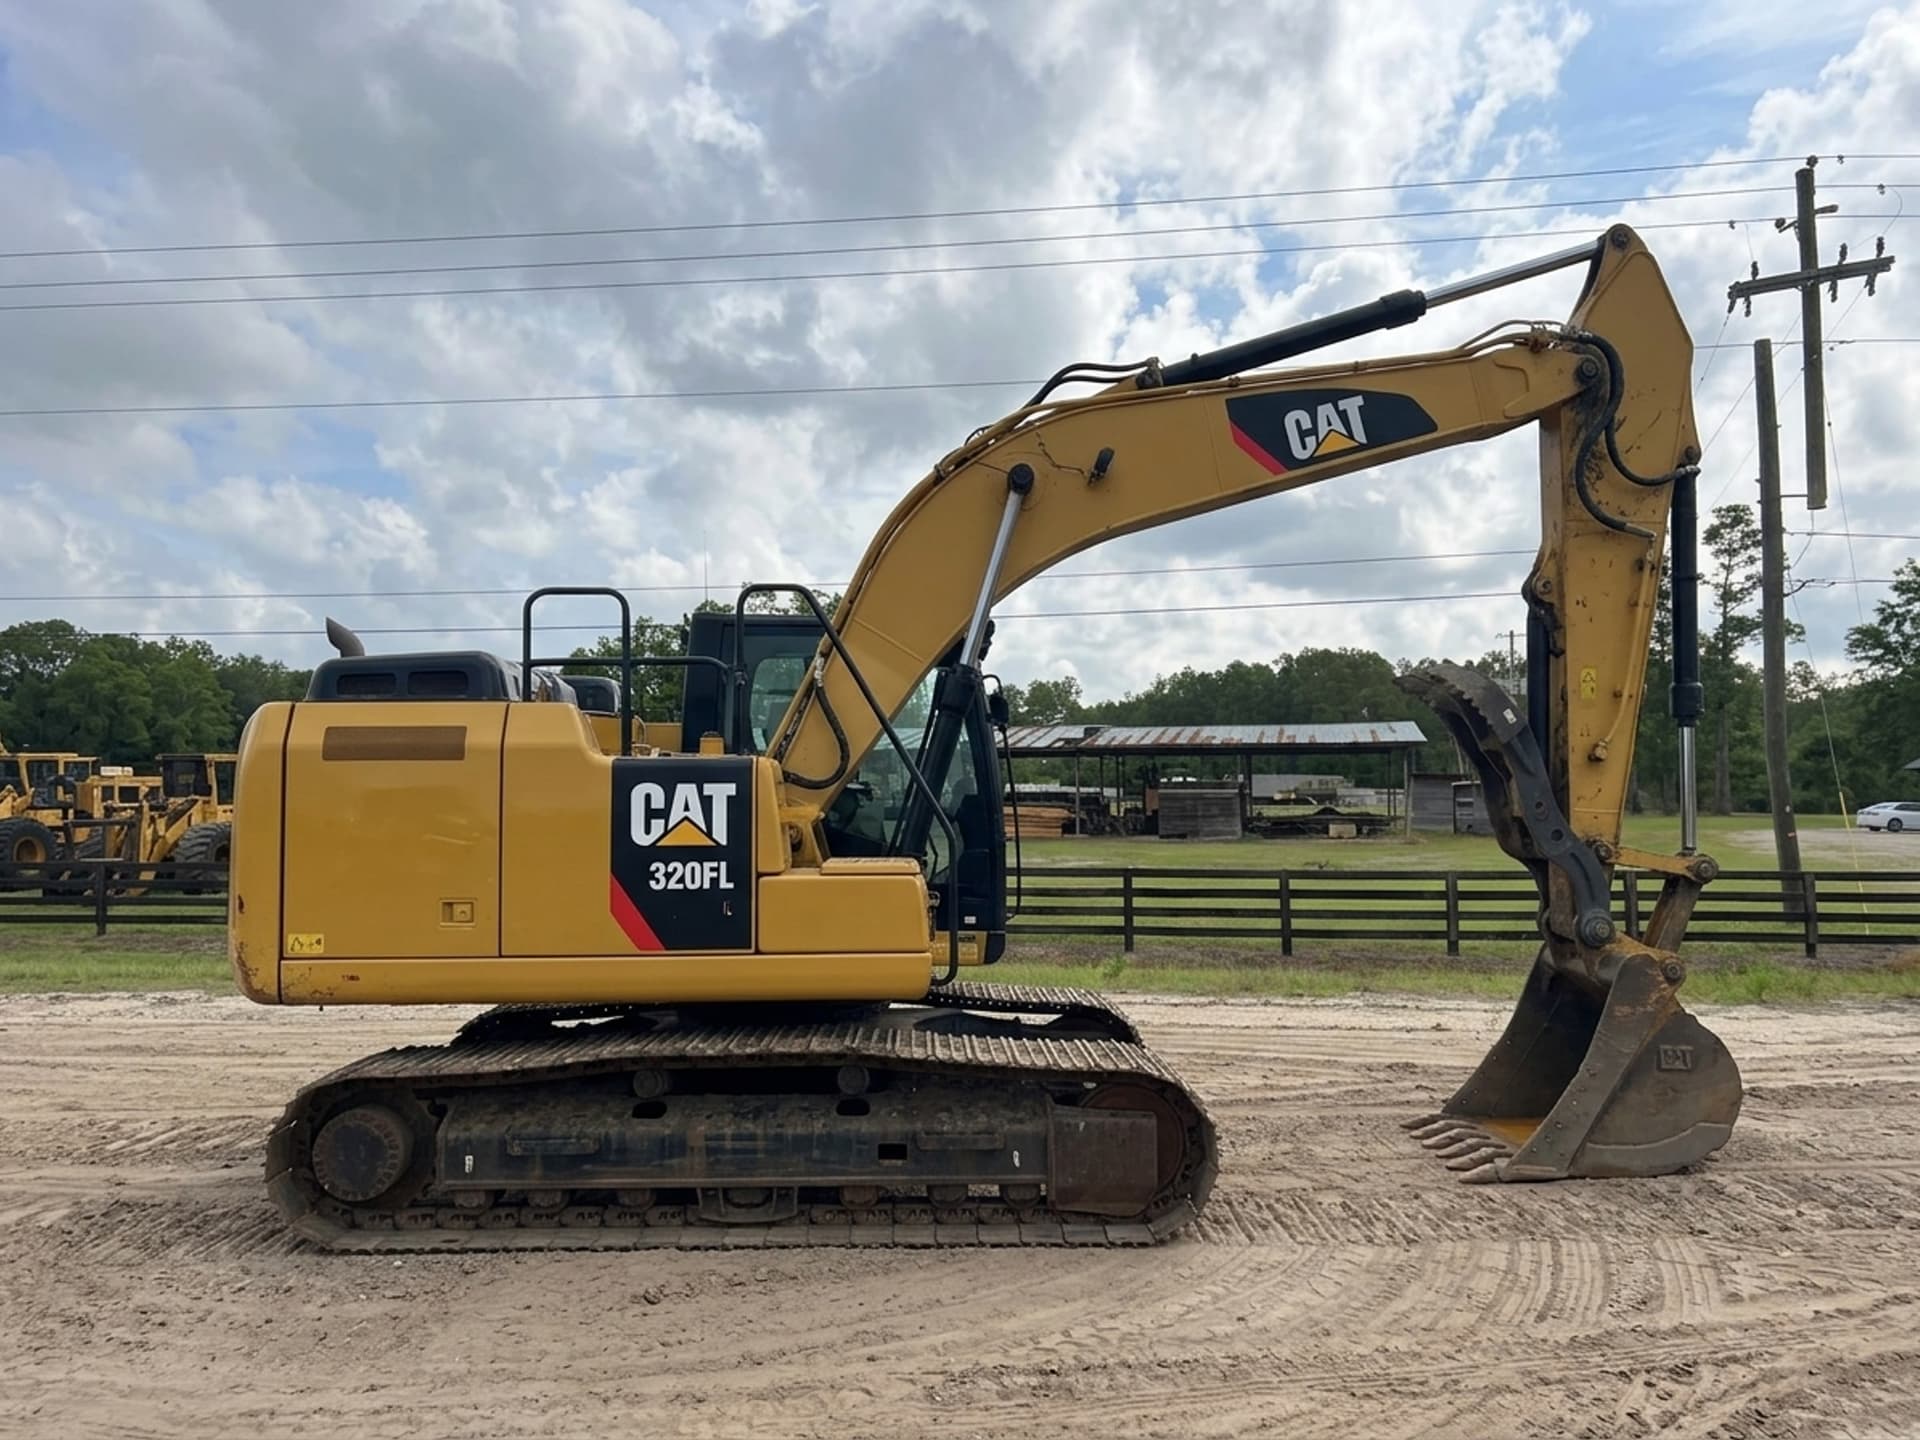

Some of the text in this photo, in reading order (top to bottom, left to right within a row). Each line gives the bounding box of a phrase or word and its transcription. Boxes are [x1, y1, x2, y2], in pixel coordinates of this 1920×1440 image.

[1284, 395, 1368, 460] CAT
[630, 782, 737, 846] CAT
[649, 861, 735, 890] 320FL
